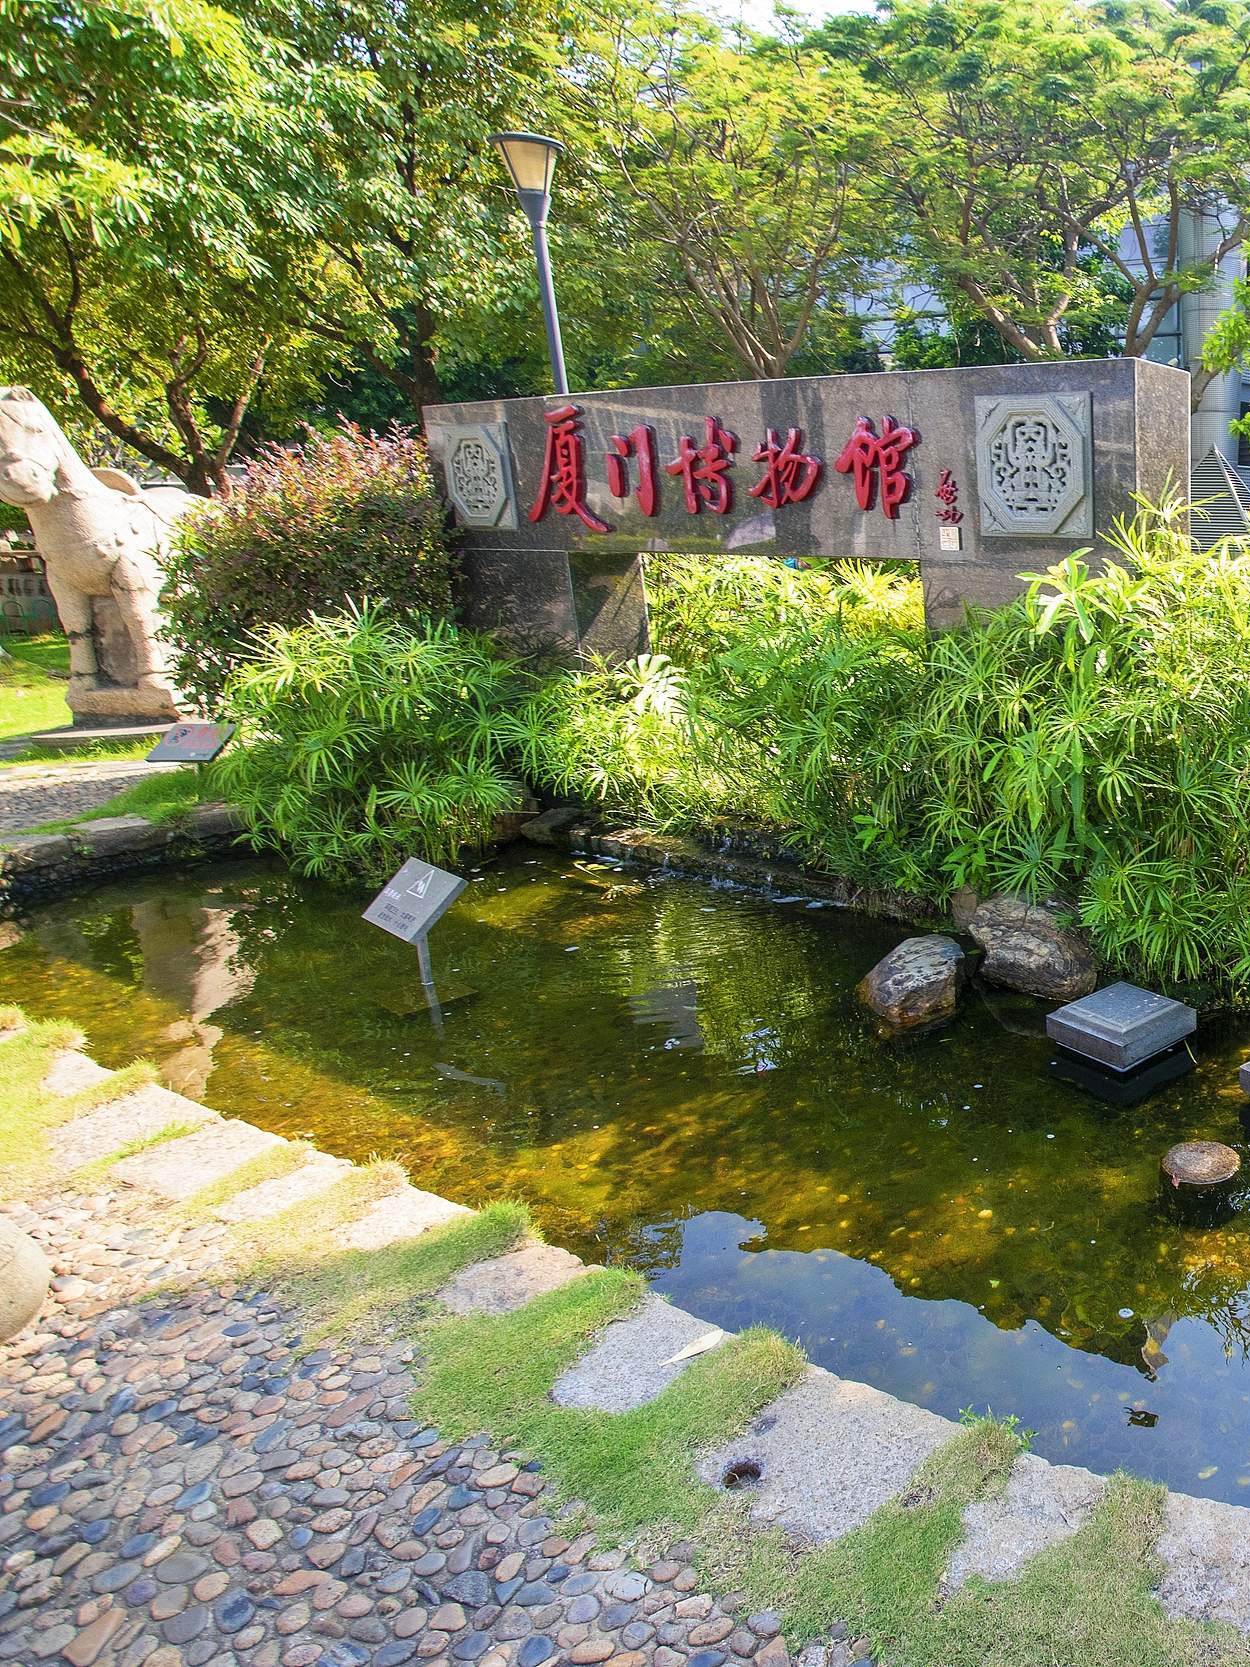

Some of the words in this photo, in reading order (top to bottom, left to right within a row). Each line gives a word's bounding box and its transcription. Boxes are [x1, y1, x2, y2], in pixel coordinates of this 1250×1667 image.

[528, 404, 917, 533] 厦门博物馆
